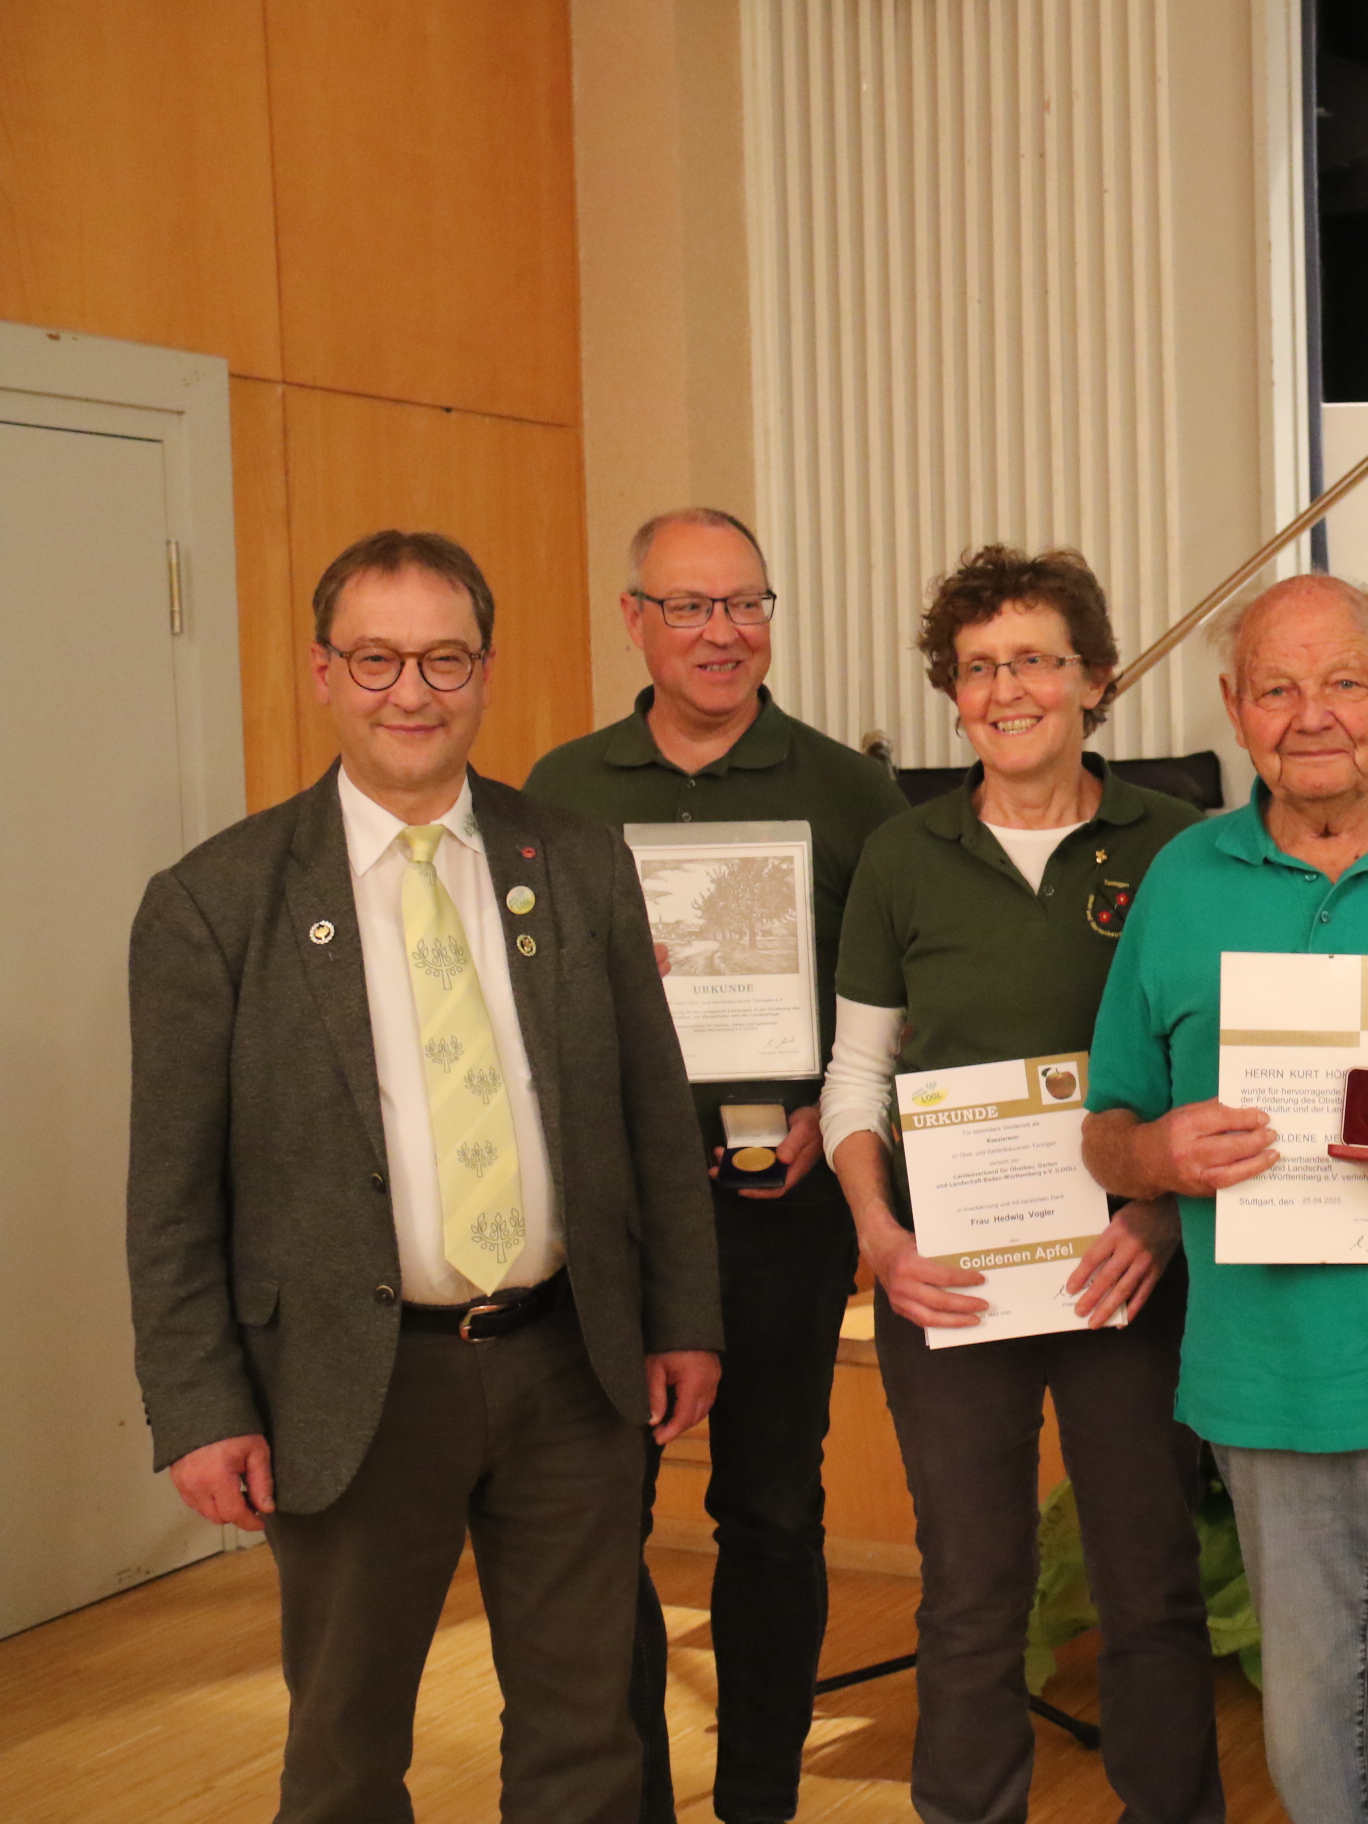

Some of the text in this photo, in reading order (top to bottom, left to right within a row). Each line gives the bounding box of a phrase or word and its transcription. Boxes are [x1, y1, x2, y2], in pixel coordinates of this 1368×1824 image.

[693, 983, 753, 994] URKUNDE
[1245, 1068, 1284, 1079] HERRN
[1289, 1069, 1319, 1079] KURT
[1240, 1087, 1341, 1097] wurde für hervorragende
[1240, 1095, 1343, 1106] der Förderung des Obstb
[912, 1105, 998, 1128] URKUNDE
[1287, 1164, 1333, 1172] Landschaft
[1239, 1197, 1276, 1207] Stuttgart,
[1278, 1197, 1294, 1206] den
[970, 1208, 1054, 1226] Frau Hedwig Vogler
[959, 1242, 1073, 1269] Goldenen Apfel
